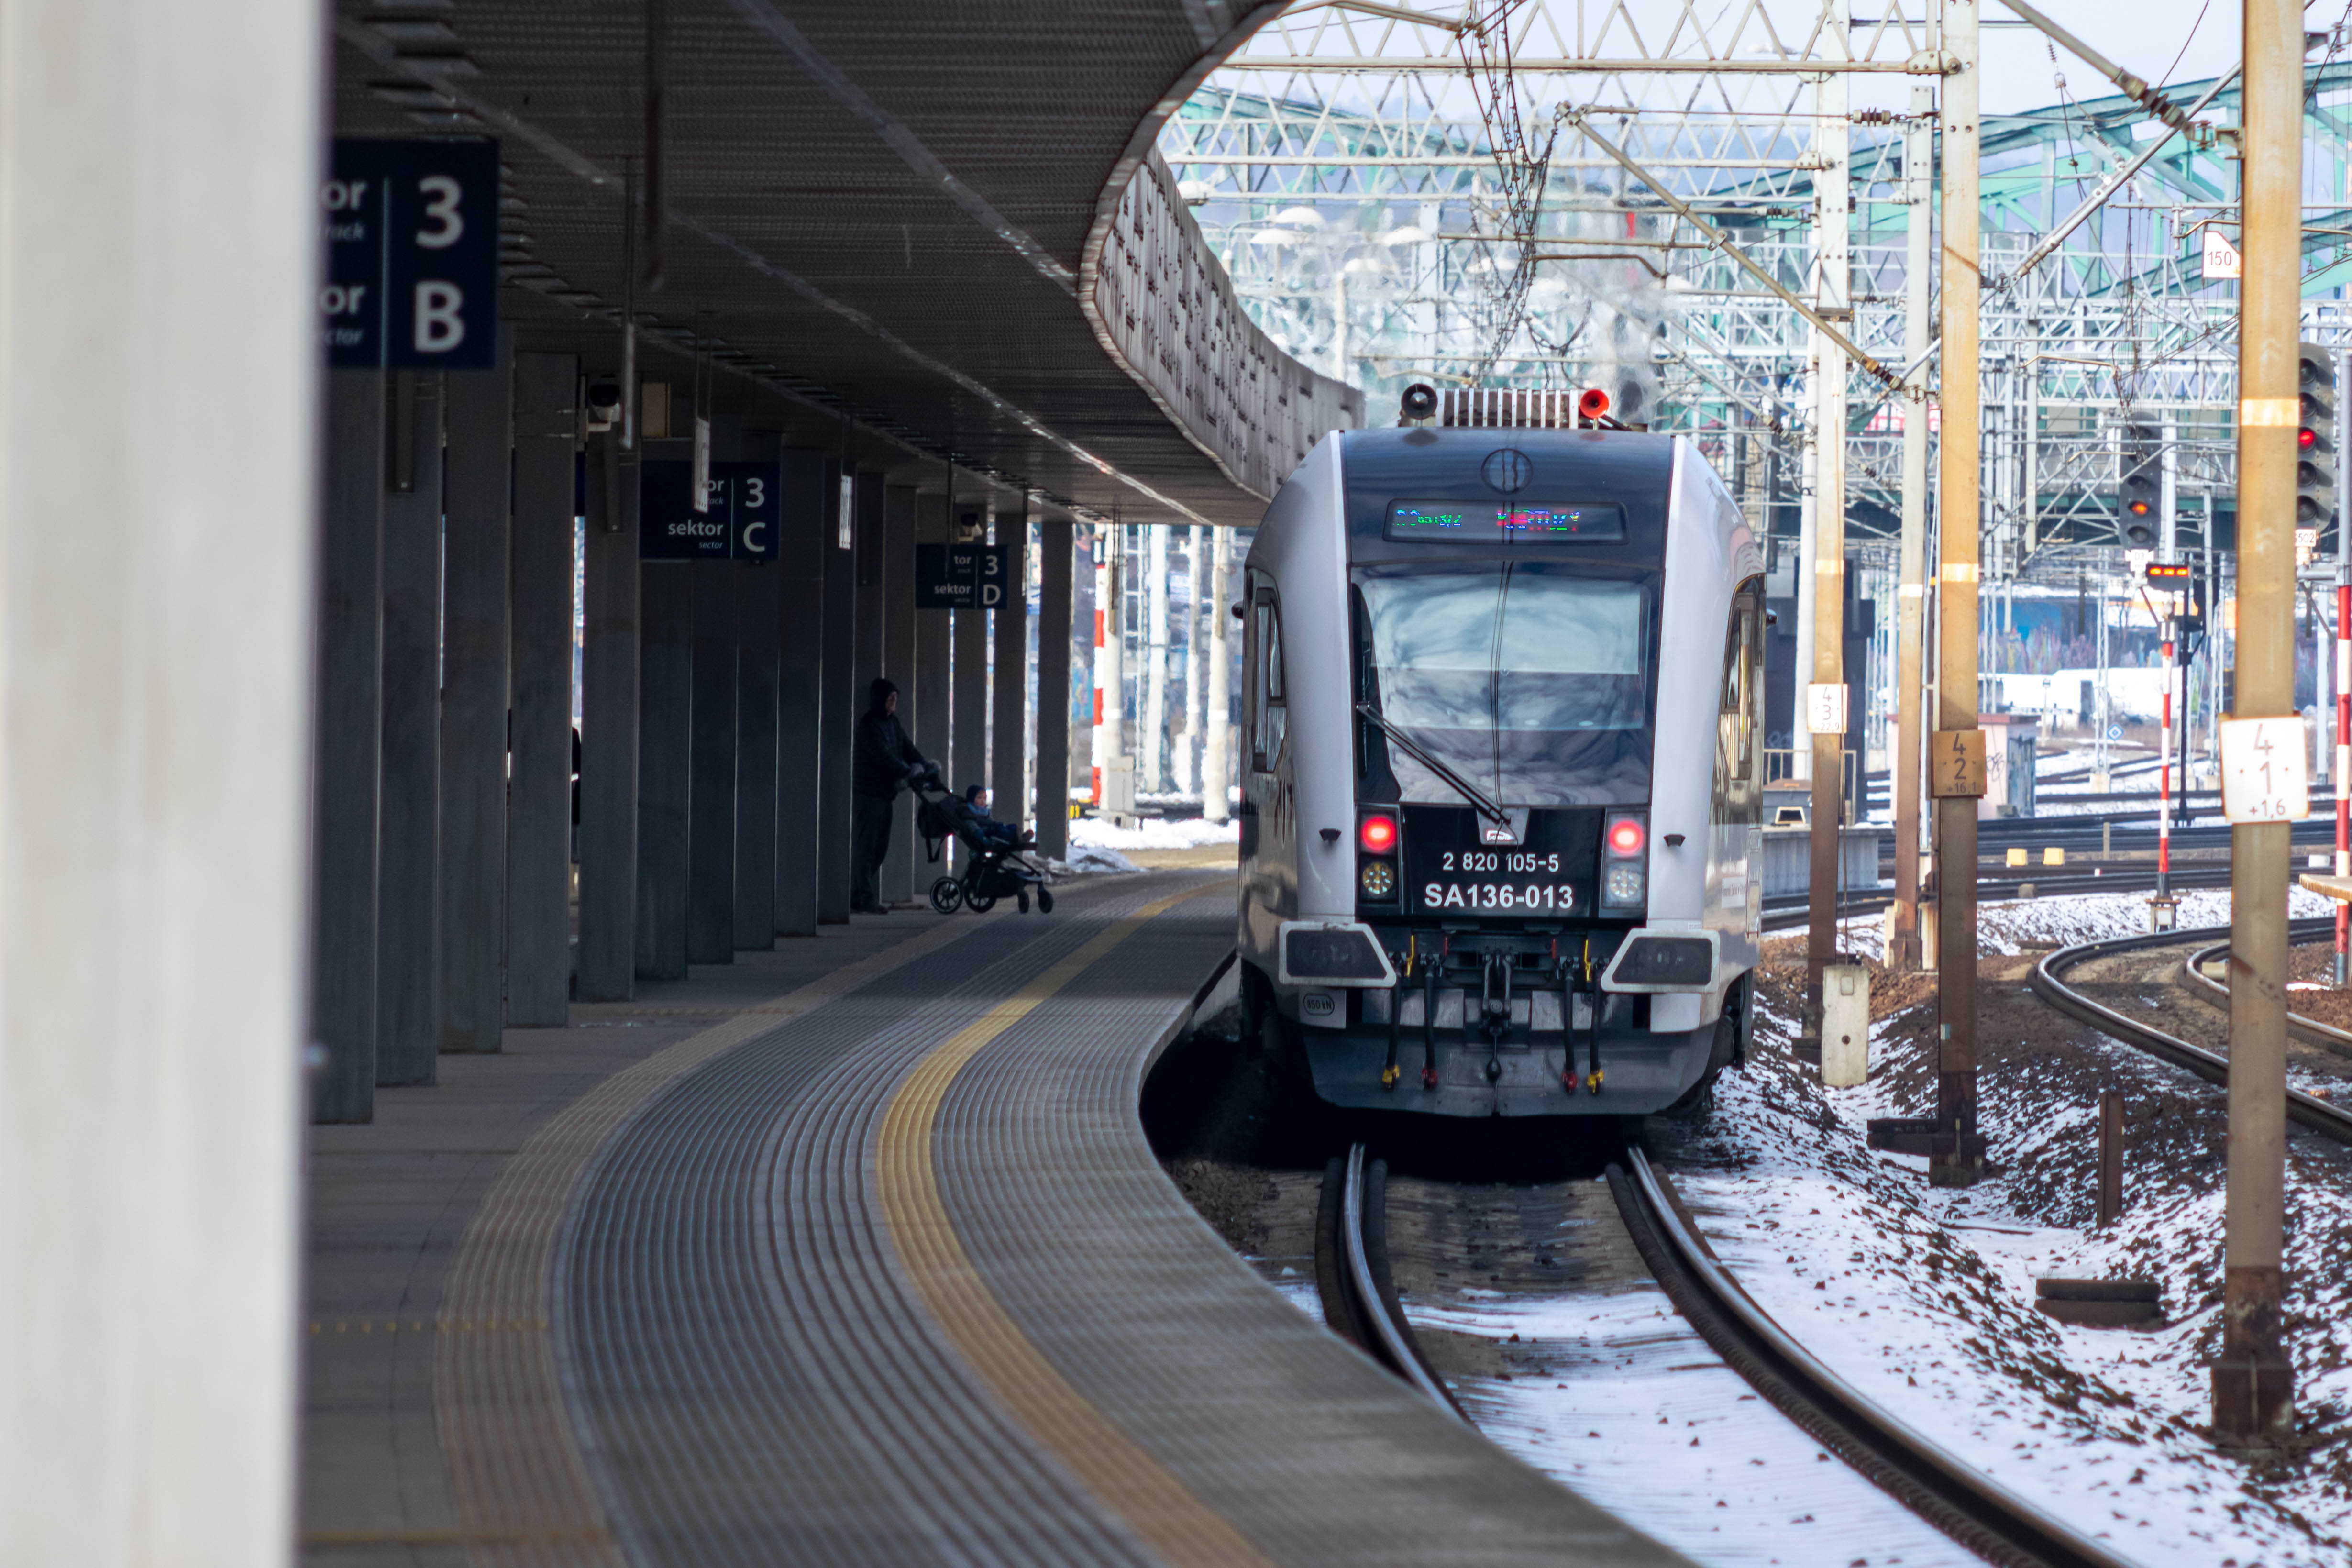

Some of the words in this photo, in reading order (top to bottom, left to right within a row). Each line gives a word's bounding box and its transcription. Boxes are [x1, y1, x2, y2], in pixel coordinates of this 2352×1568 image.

[320, 180, 367, 210] or
[416, 175, 464, 248] 3
[2207, 250, 2232, 266] 150
[413, 279, 465, 353] B
[708, 479, 724, 492] or
[745, 477, 765, 508] 3
[668, 519, 724, 536] sektor
[743, 521, 766, 552] C
[953, 555, 972, 565] tor
[984, 554, 999, 576] 3
[933, 582, 972, 595] sektor
[982, 584, 1001, 605] D
[1822, 686, 1832, 702] 4
[1822, 704, 1832, 721] 3
[1952, 733, 1966, 755] 4
[2253, 723, 2274, 756] 4
[1954, 757, 1967, 780] 2
[2259, 761, 2271, 795] 1
[1442, 851, 1454, 871] 2
[1462, 852, 1498, 872] 820
[1506, 853, 1559, 872] 105-5
[1424, 883, 1573, 909] SA136-013
